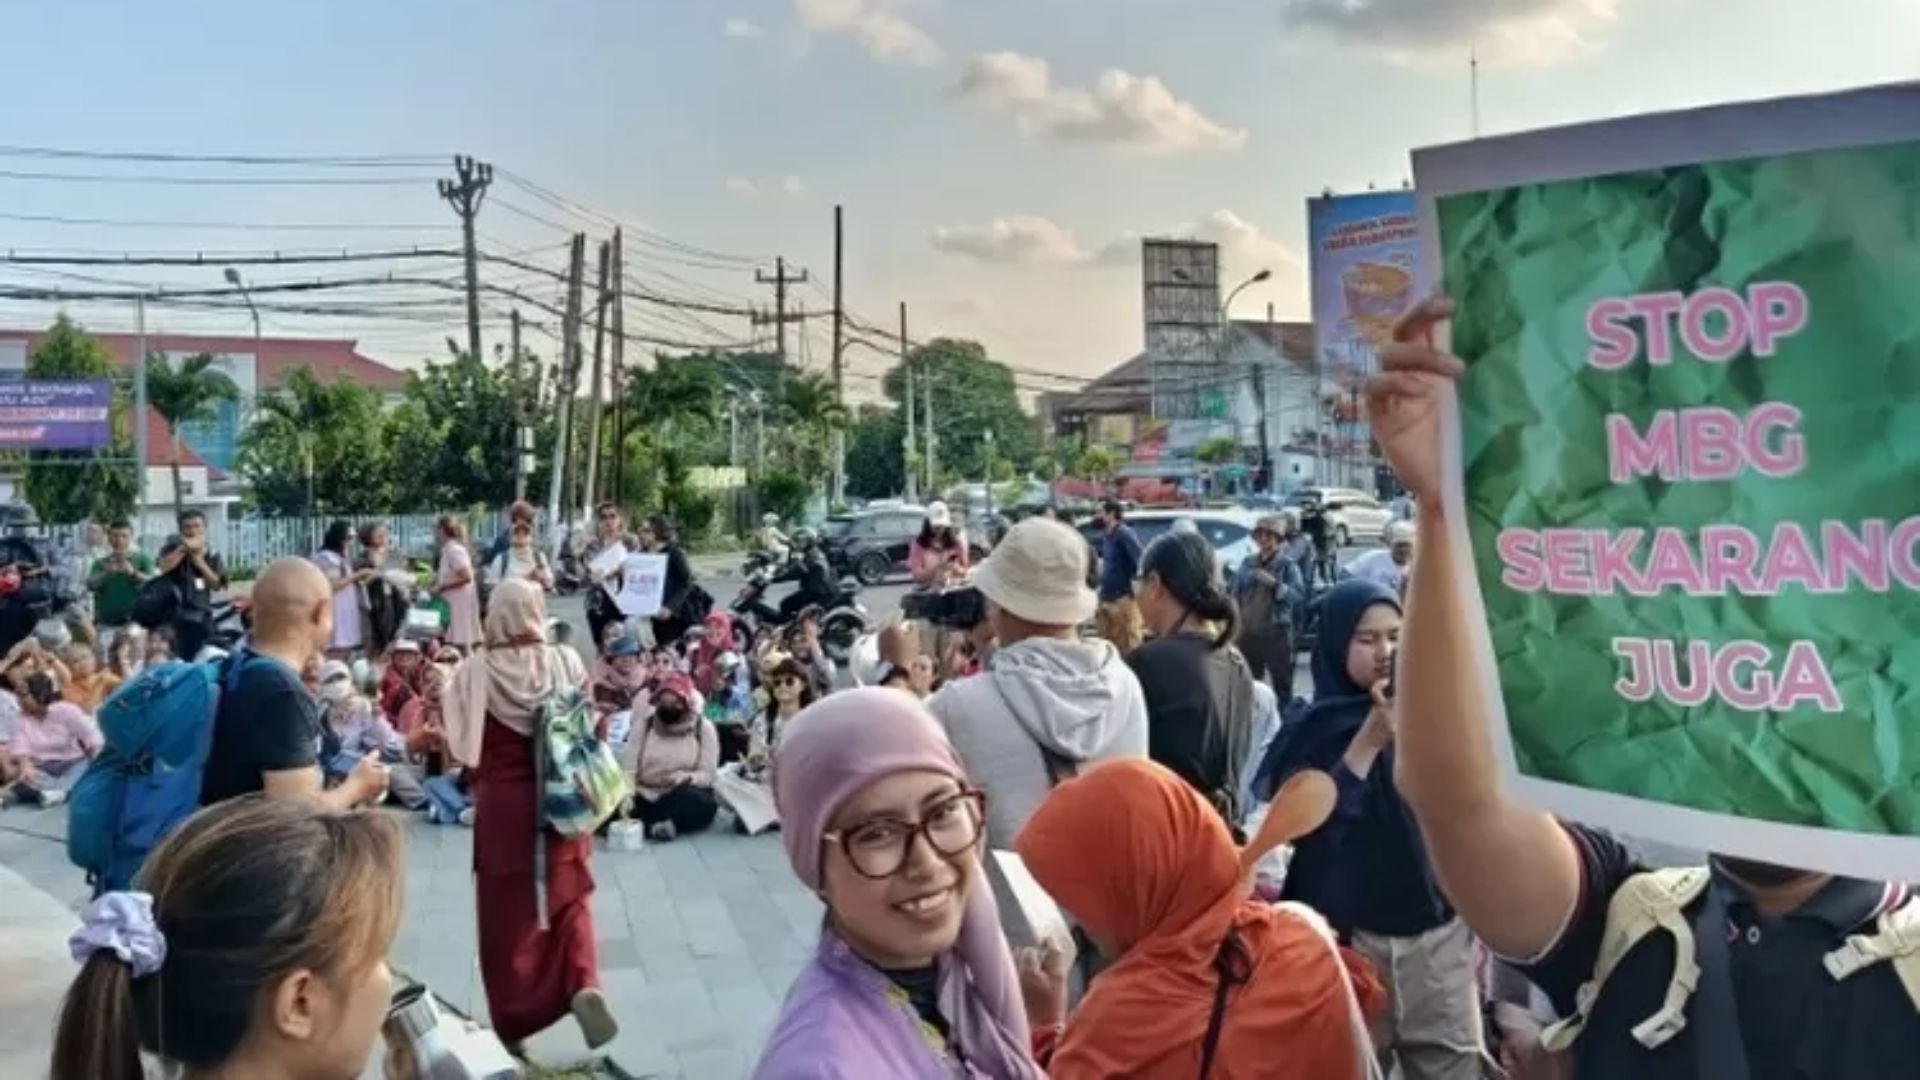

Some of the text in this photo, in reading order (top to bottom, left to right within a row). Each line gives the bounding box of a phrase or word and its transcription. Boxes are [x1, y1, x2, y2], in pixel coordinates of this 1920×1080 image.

[1587, 283, 1807, 369] STOP
[1607, 403, 1804, 482] MBG
[1613, 638, 1842, 711] JUGA
